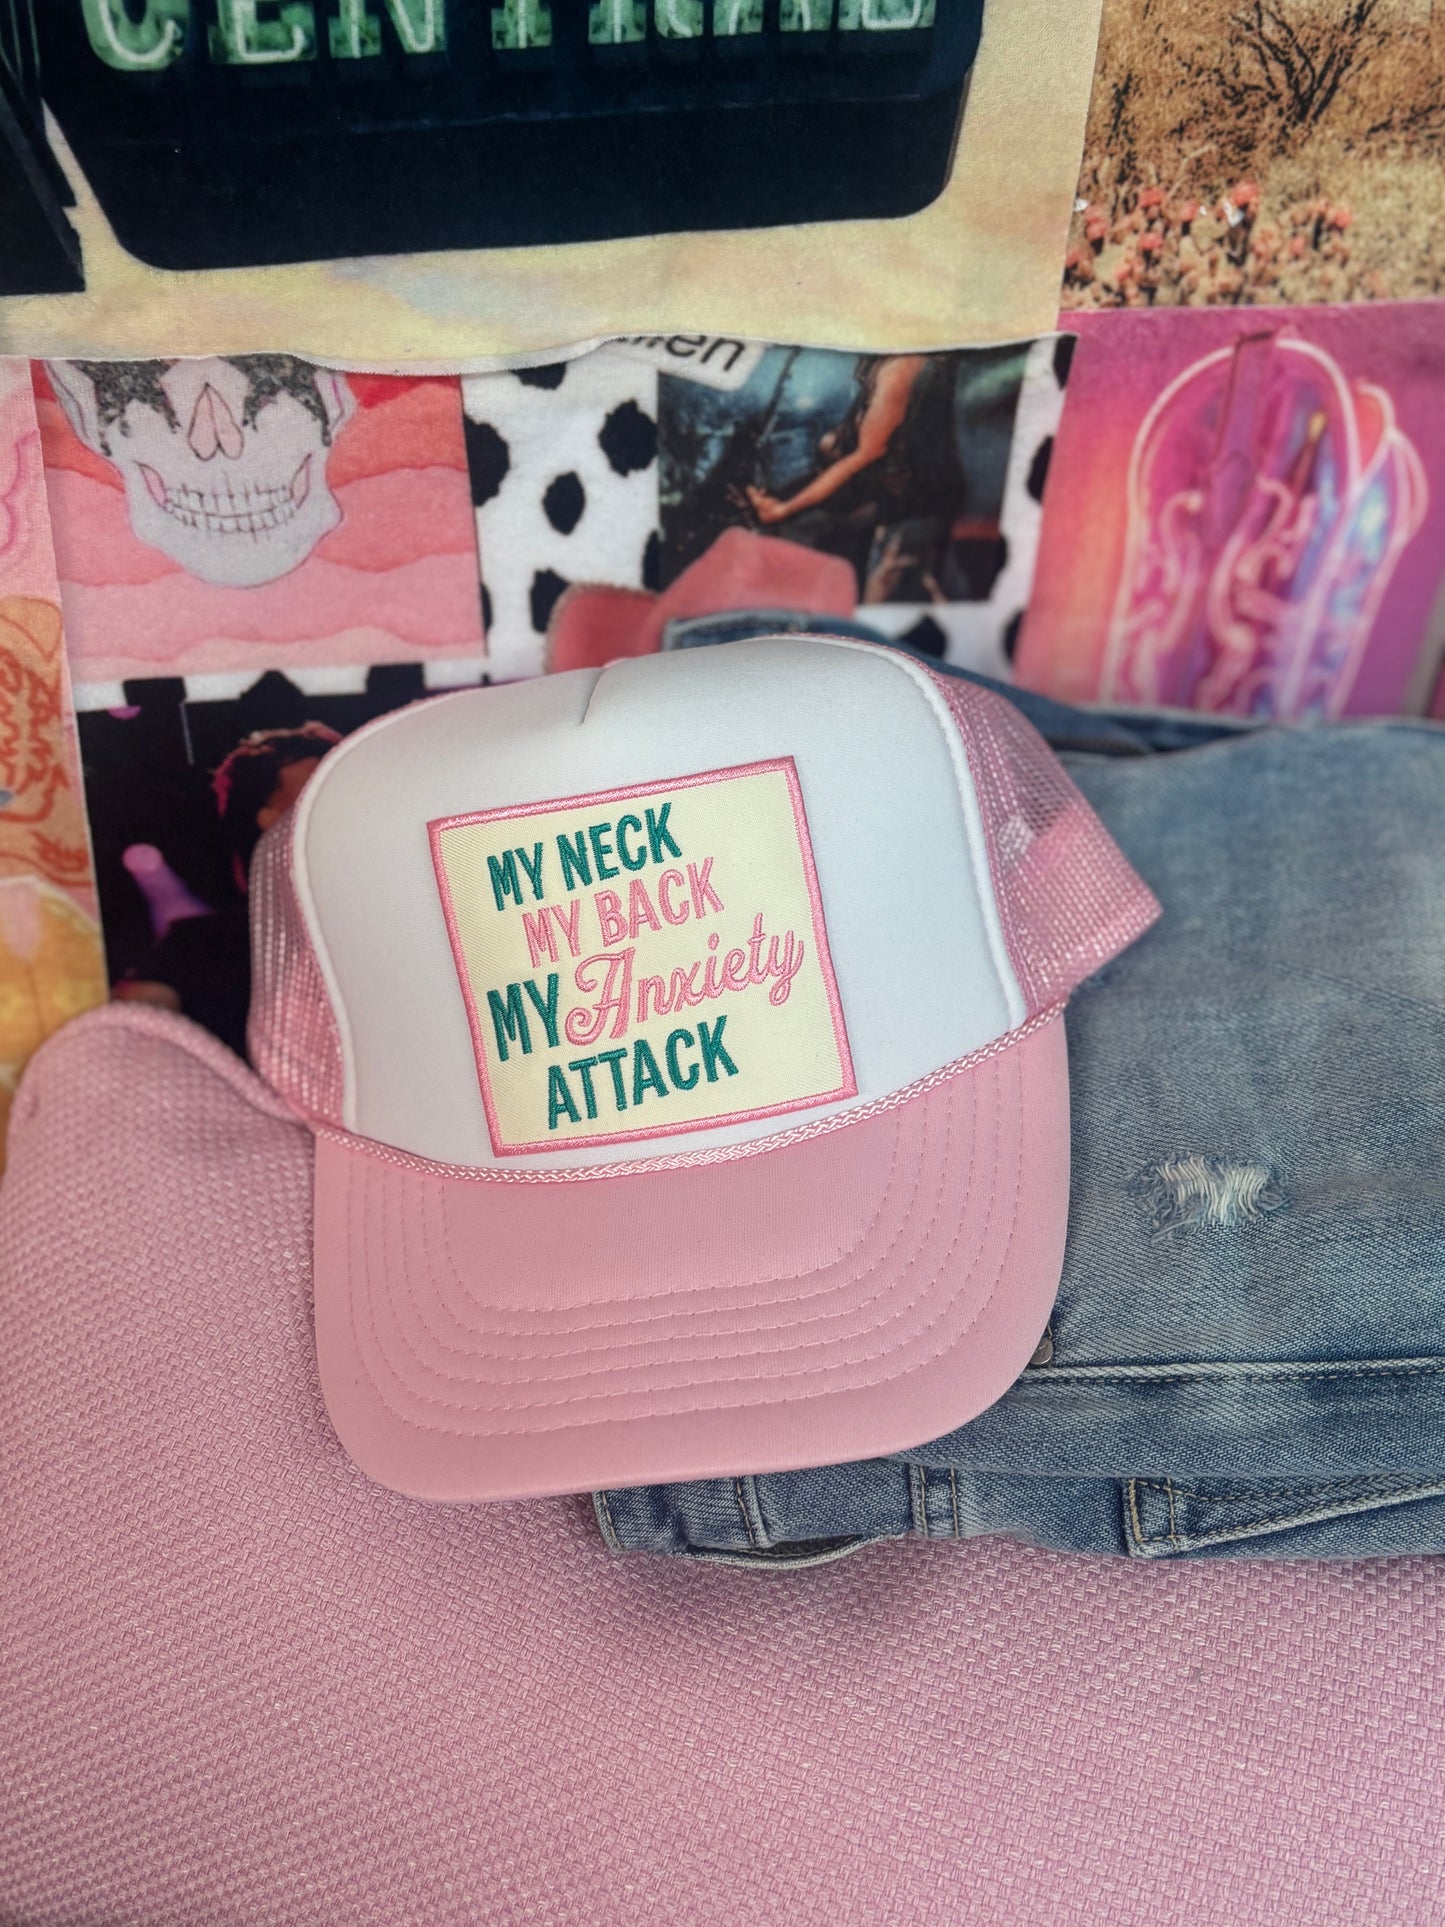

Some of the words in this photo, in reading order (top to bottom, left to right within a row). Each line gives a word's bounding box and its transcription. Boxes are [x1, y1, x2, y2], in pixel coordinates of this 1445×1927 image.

[487, 842, 544, 911] MY
[557, 803, 682, 890] NECK
[522, 900, 581, 968] MY
[594, 857, 724, 947] BACK
[487, 974, 560, 1061] MY
[565, 913, 804, 1046] Anxiety
[548, 1015, 738, 1129] ATTACK
